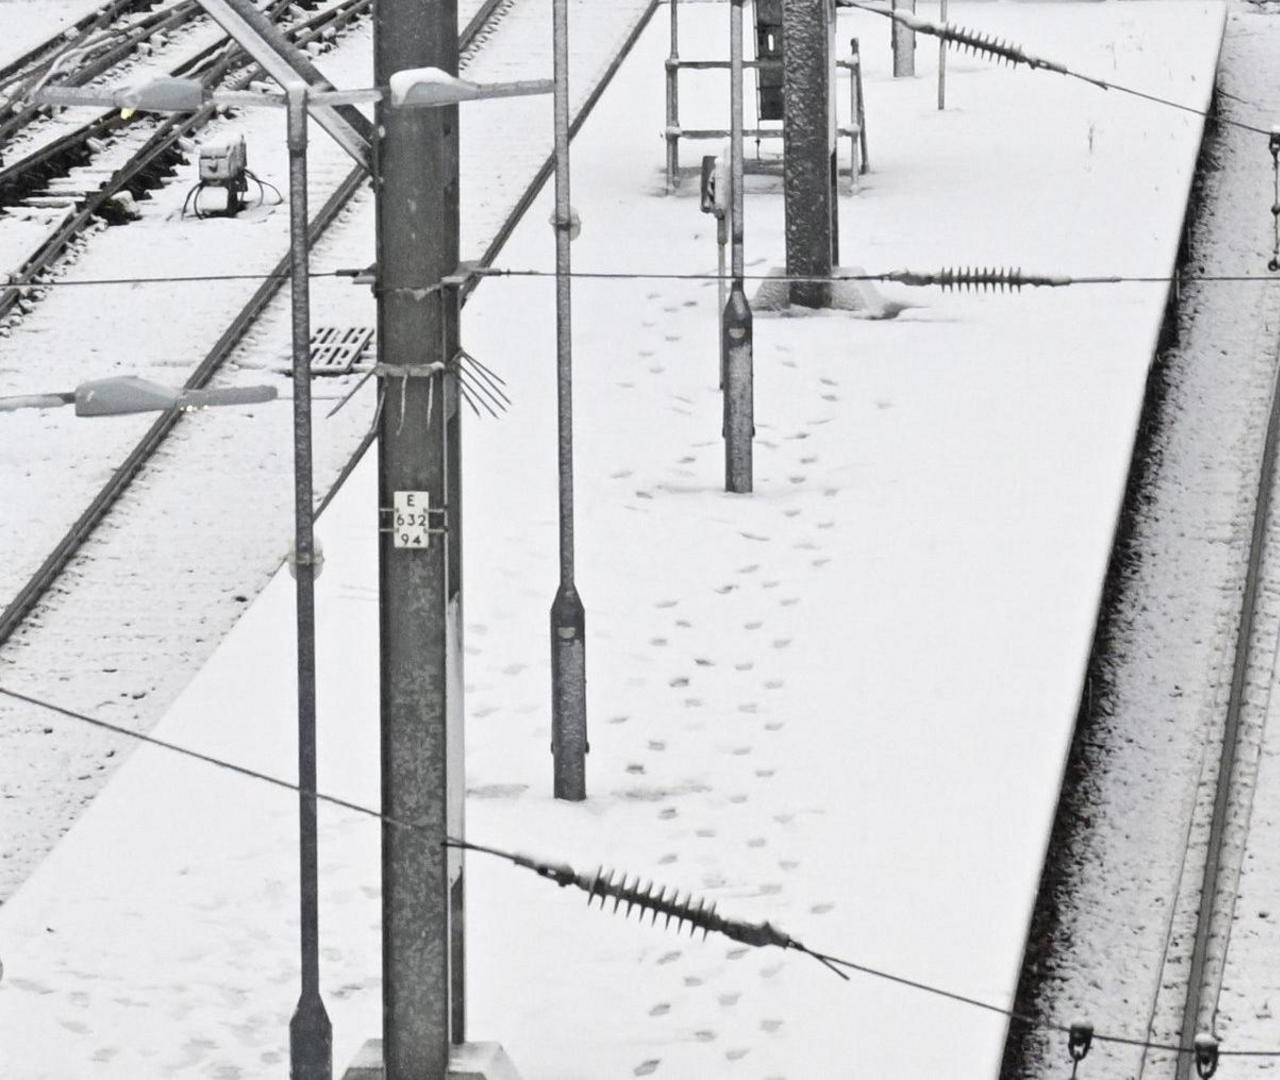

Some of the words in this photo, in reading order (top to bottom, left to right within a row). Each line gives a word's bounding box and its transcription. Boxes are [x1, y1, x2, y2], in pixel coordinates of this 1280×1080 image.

[407, 494, 415, 507] E
[396, 514, 427, 527] 632
[401, 533, 422, 546] 94
